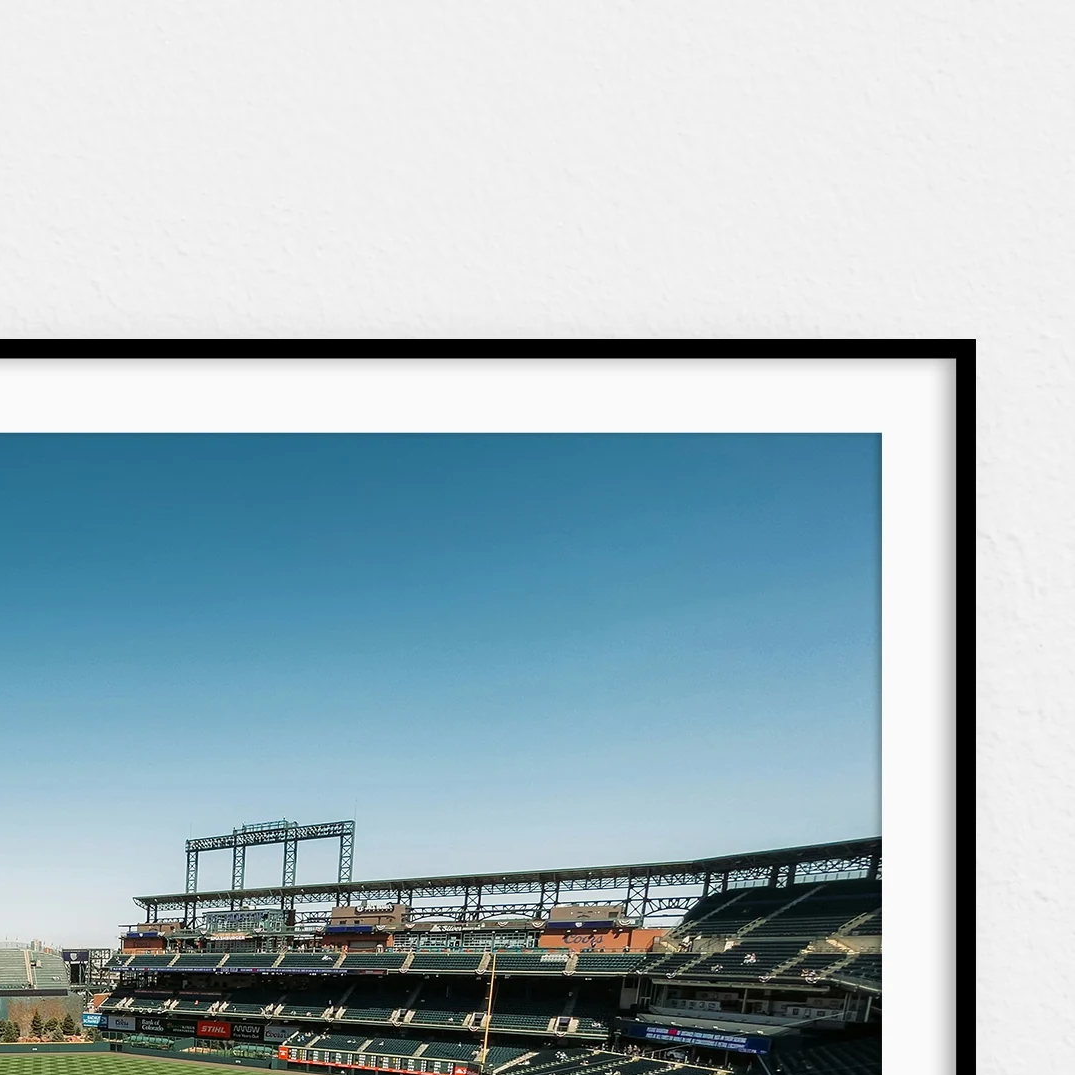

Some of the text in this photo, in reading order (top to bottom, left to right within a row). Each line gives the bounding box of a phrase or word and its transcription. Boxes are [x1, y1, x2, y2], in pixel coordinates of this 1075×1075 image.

[563, 934, 603, 944] Coors
[141, 1024, 164, 1032] Colorado
[201, 1025, 226, 1034] STIHL
